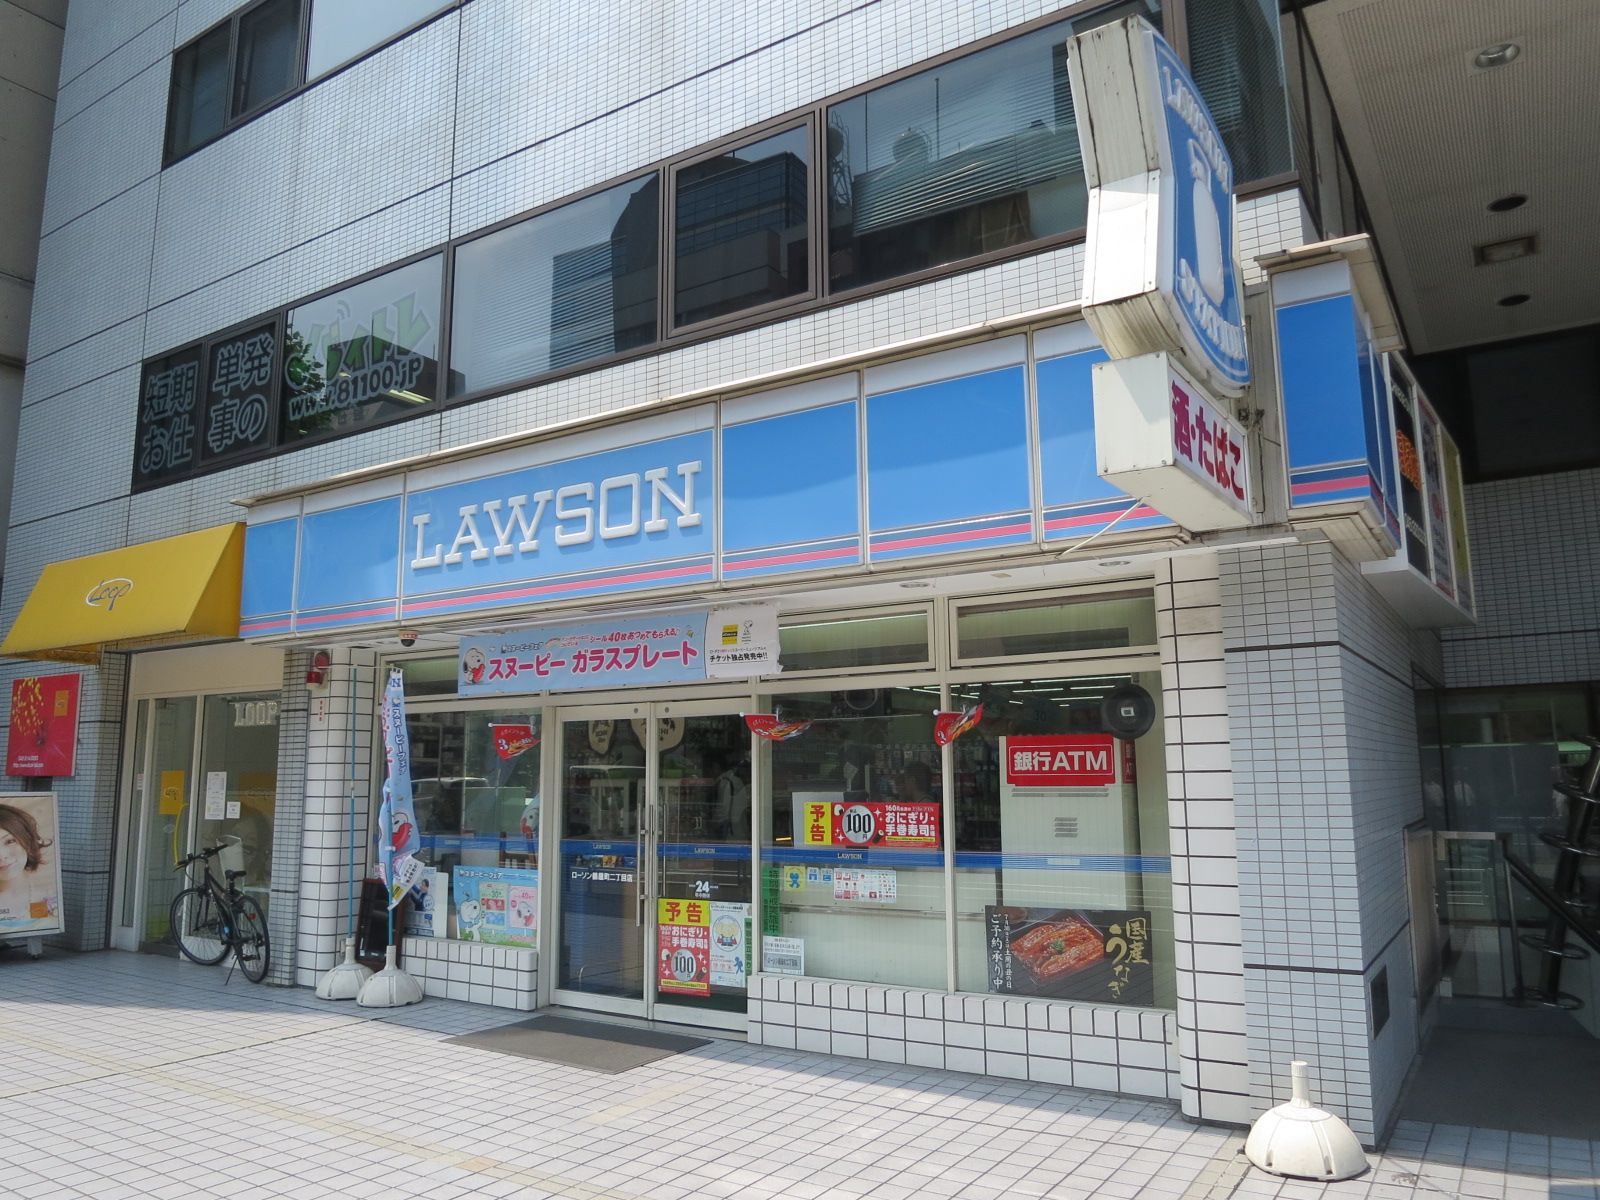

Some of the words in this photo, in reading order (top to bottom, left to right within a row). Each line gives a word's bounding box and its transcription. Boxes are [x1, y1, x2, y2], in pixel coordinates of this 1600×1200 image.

[1171, 380, 1245, 501] 酒・たばこ
[411, 460, 702, 570] LAWSON
[488, 652, 566, 681] スヌーピー
[571, 640, 699, 674] ガラスプレート
[1014, 750, 1108, 772] 銀行ATM
[810, 804, 825, 842] 予告
[846, 813, 872, 834] 100
[885, 824, 930, 836] 手巻寿司
[695, 880, 710, 893] 24
[665, 902, 702, 923] 予告
[990, 913, 1004, 989] ご予約承り中
[673, 956, 694, 974] 100
